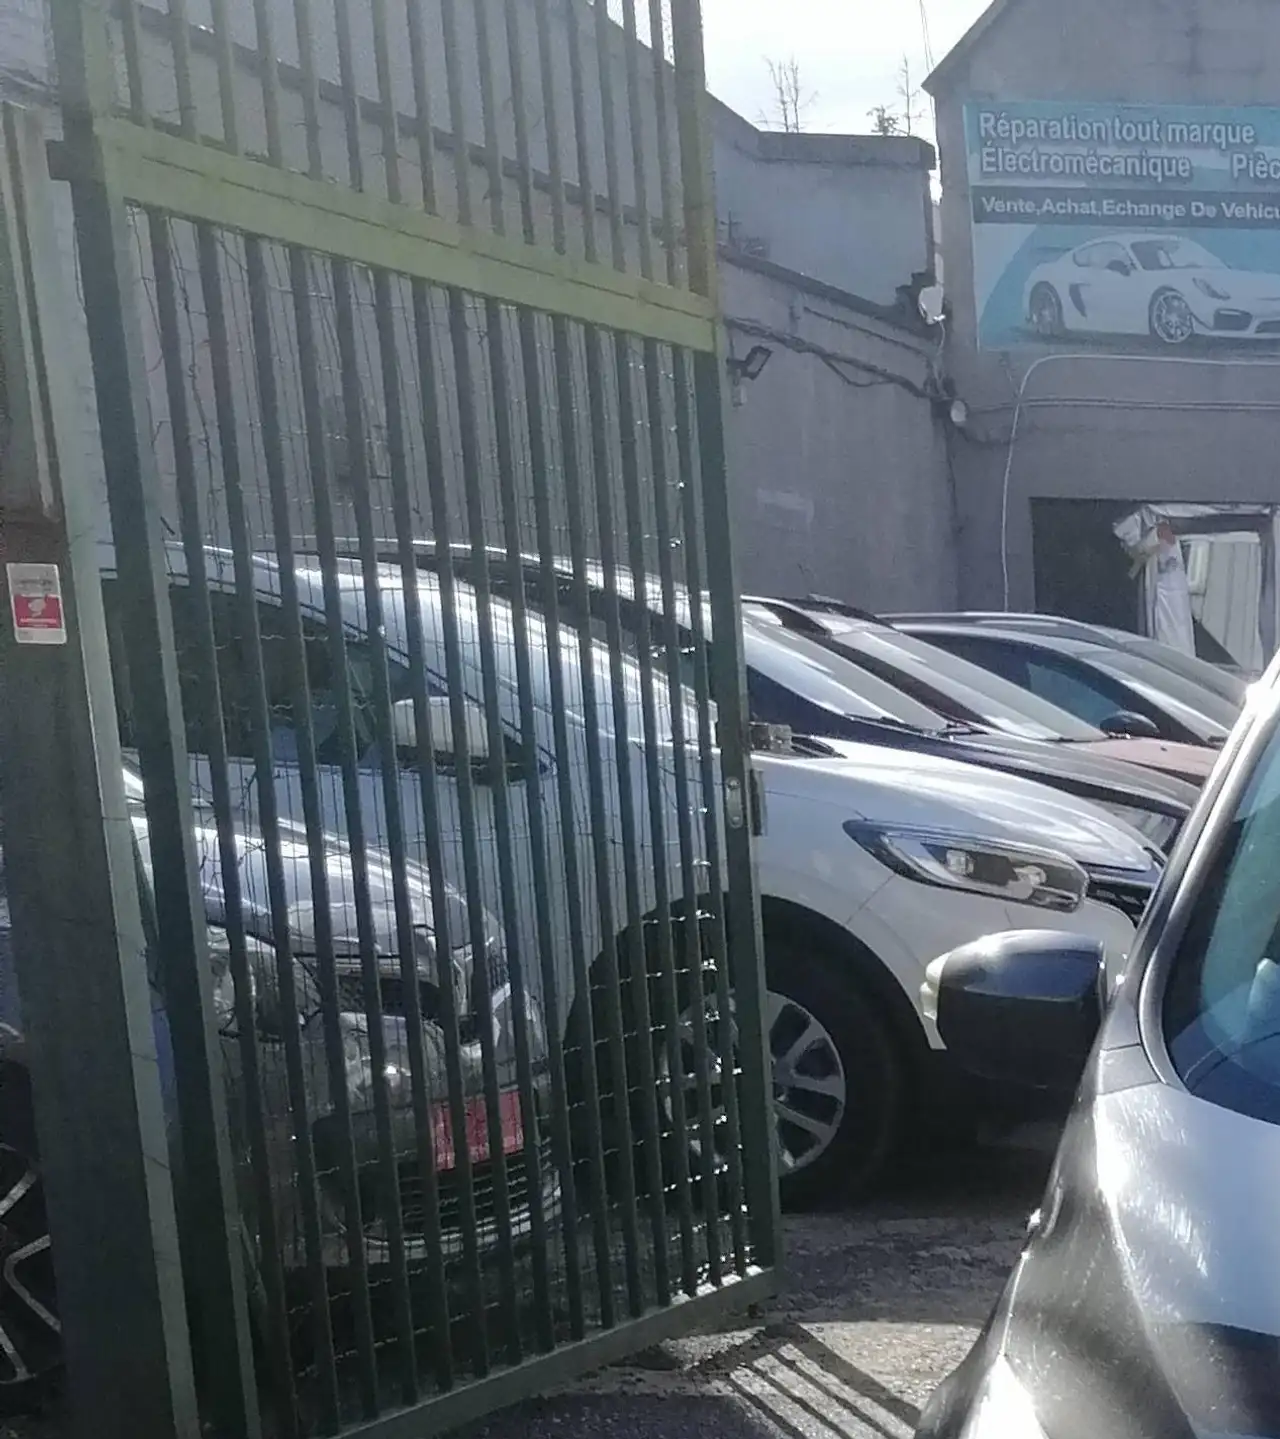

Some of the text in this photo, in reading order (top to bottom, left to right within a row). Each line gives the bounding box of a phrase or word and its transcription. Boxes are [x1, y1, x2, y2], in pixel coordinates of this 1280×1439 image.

[979, 113, 1254, 149] Réparation tout marque
[982, 140, 1191, 182] Électromécanique
[1191, 202, 1216, 218] De
